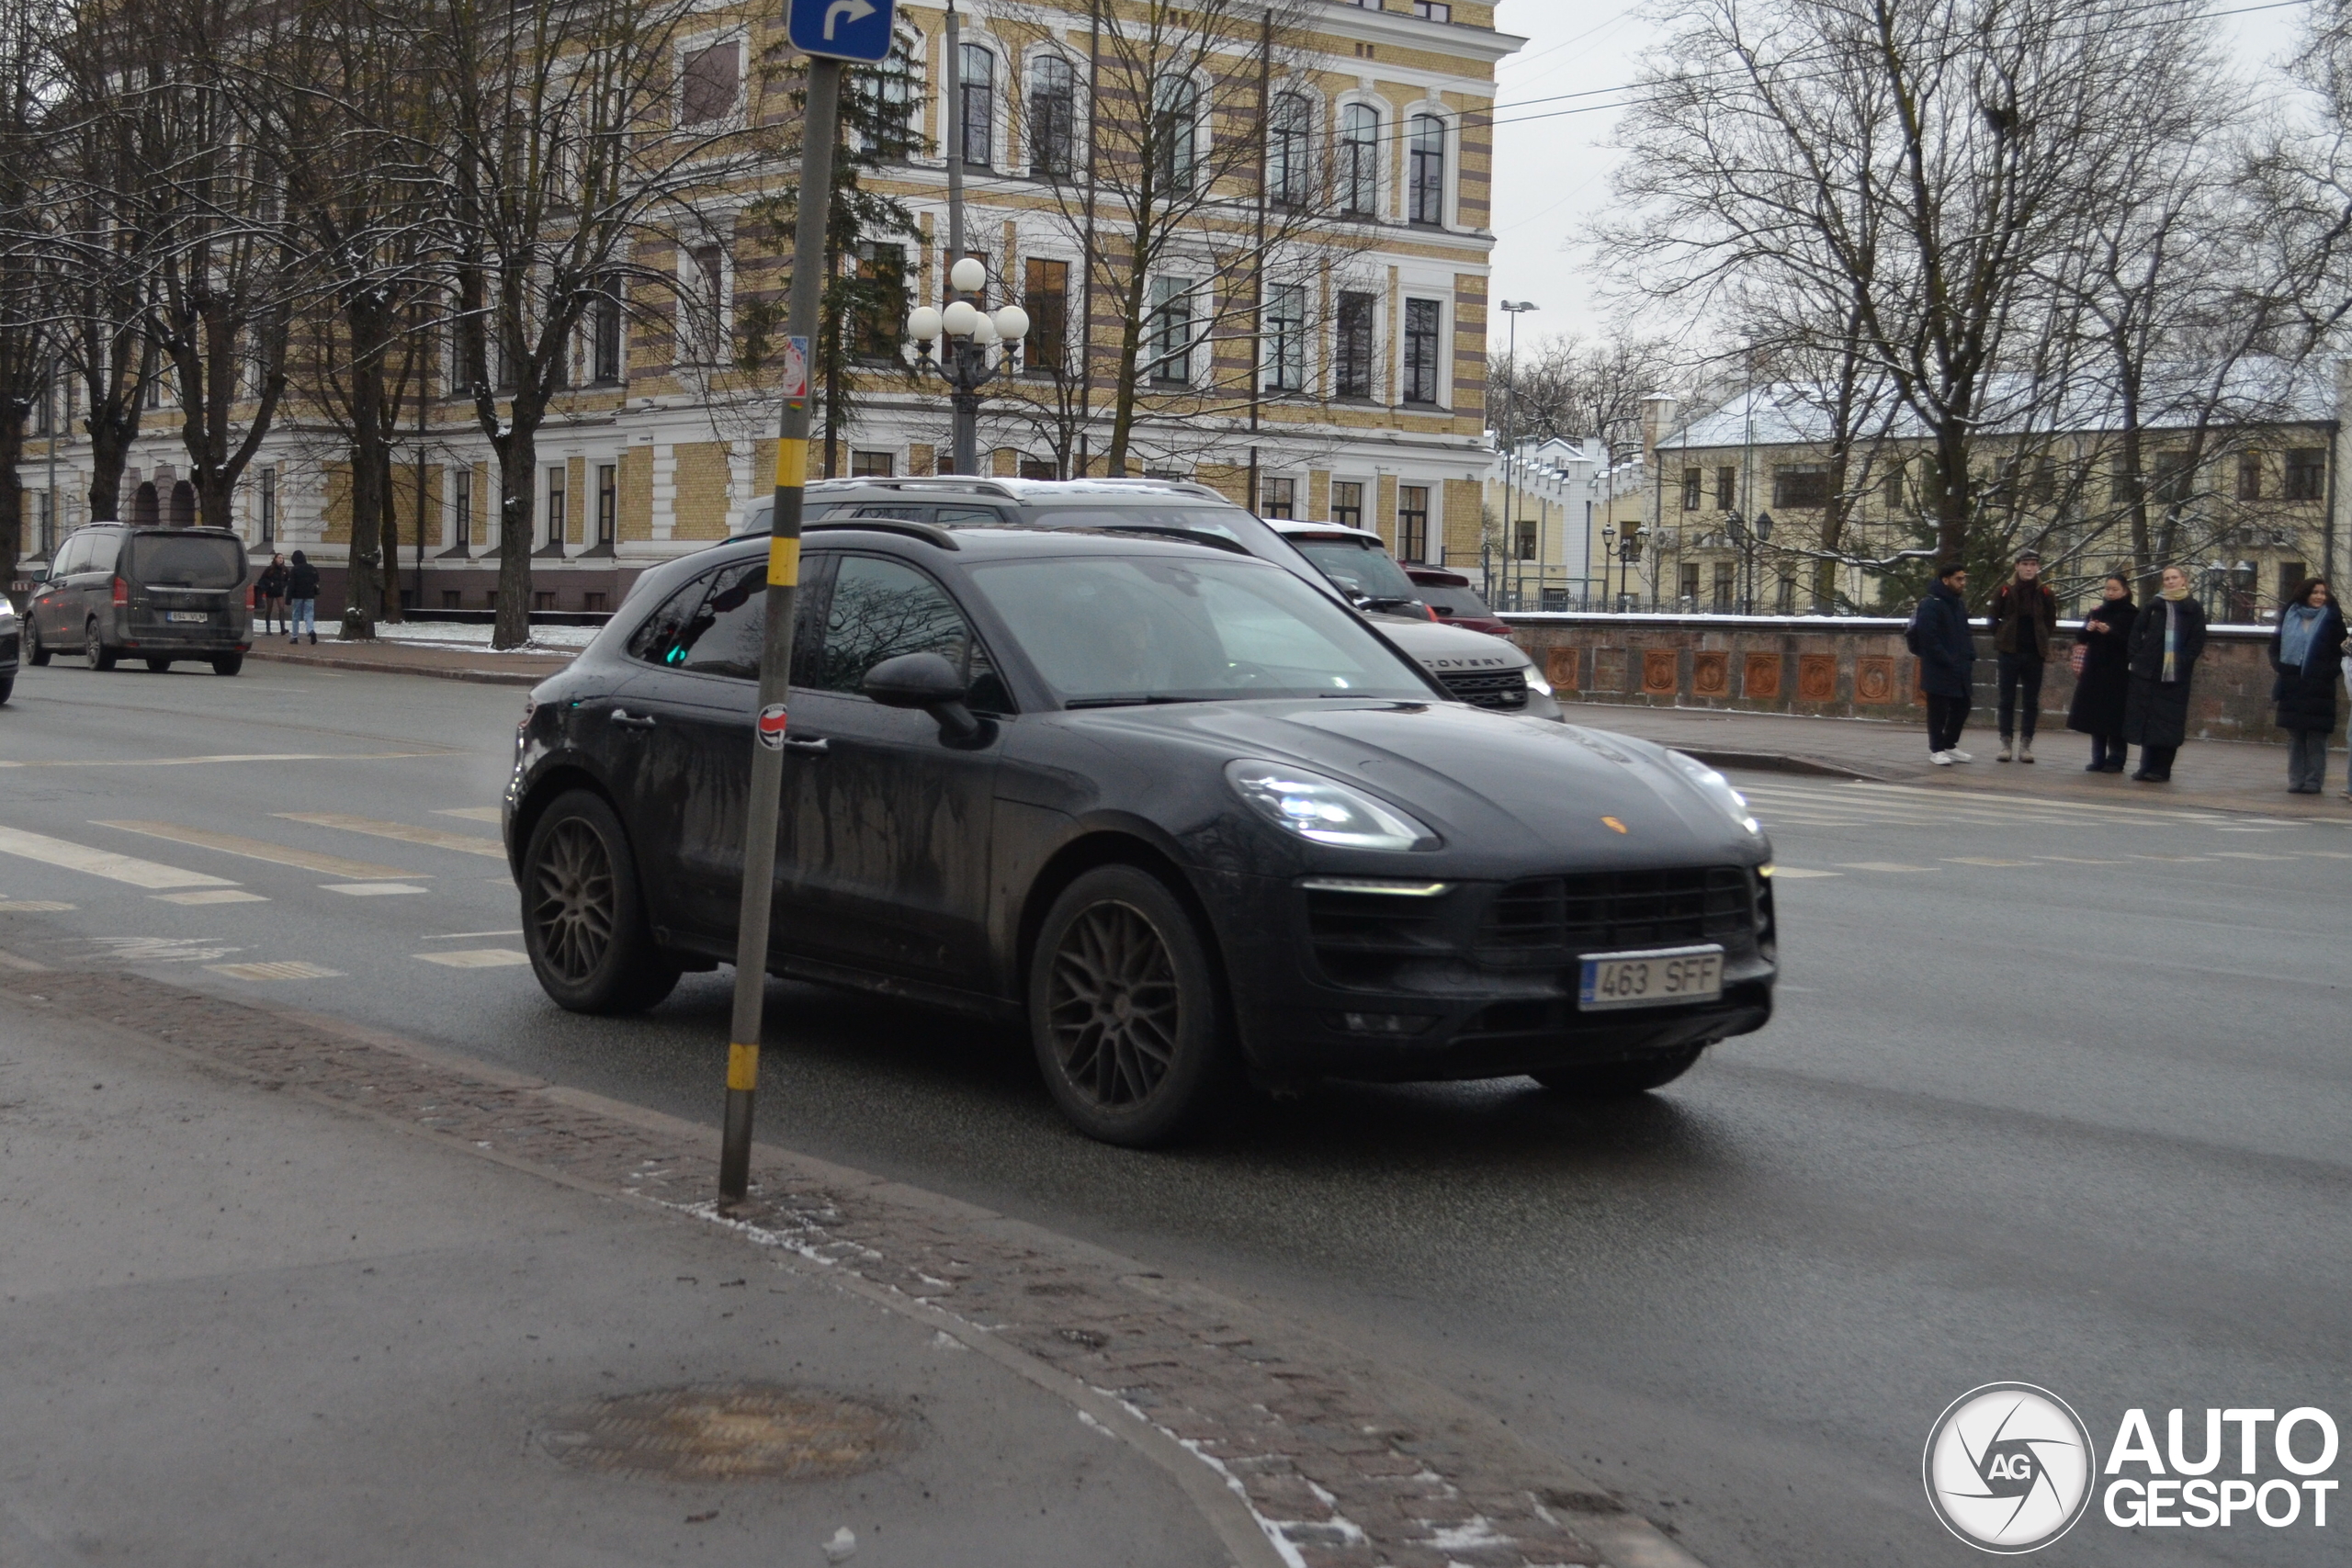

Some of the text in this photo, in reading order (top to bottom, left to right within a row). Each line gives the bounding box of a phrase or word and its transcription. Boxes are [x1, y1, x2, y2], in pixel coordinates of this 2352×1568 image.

[172, 612, 186, 620] 894
[1601, 957, 1716, 996] 463 SFF
